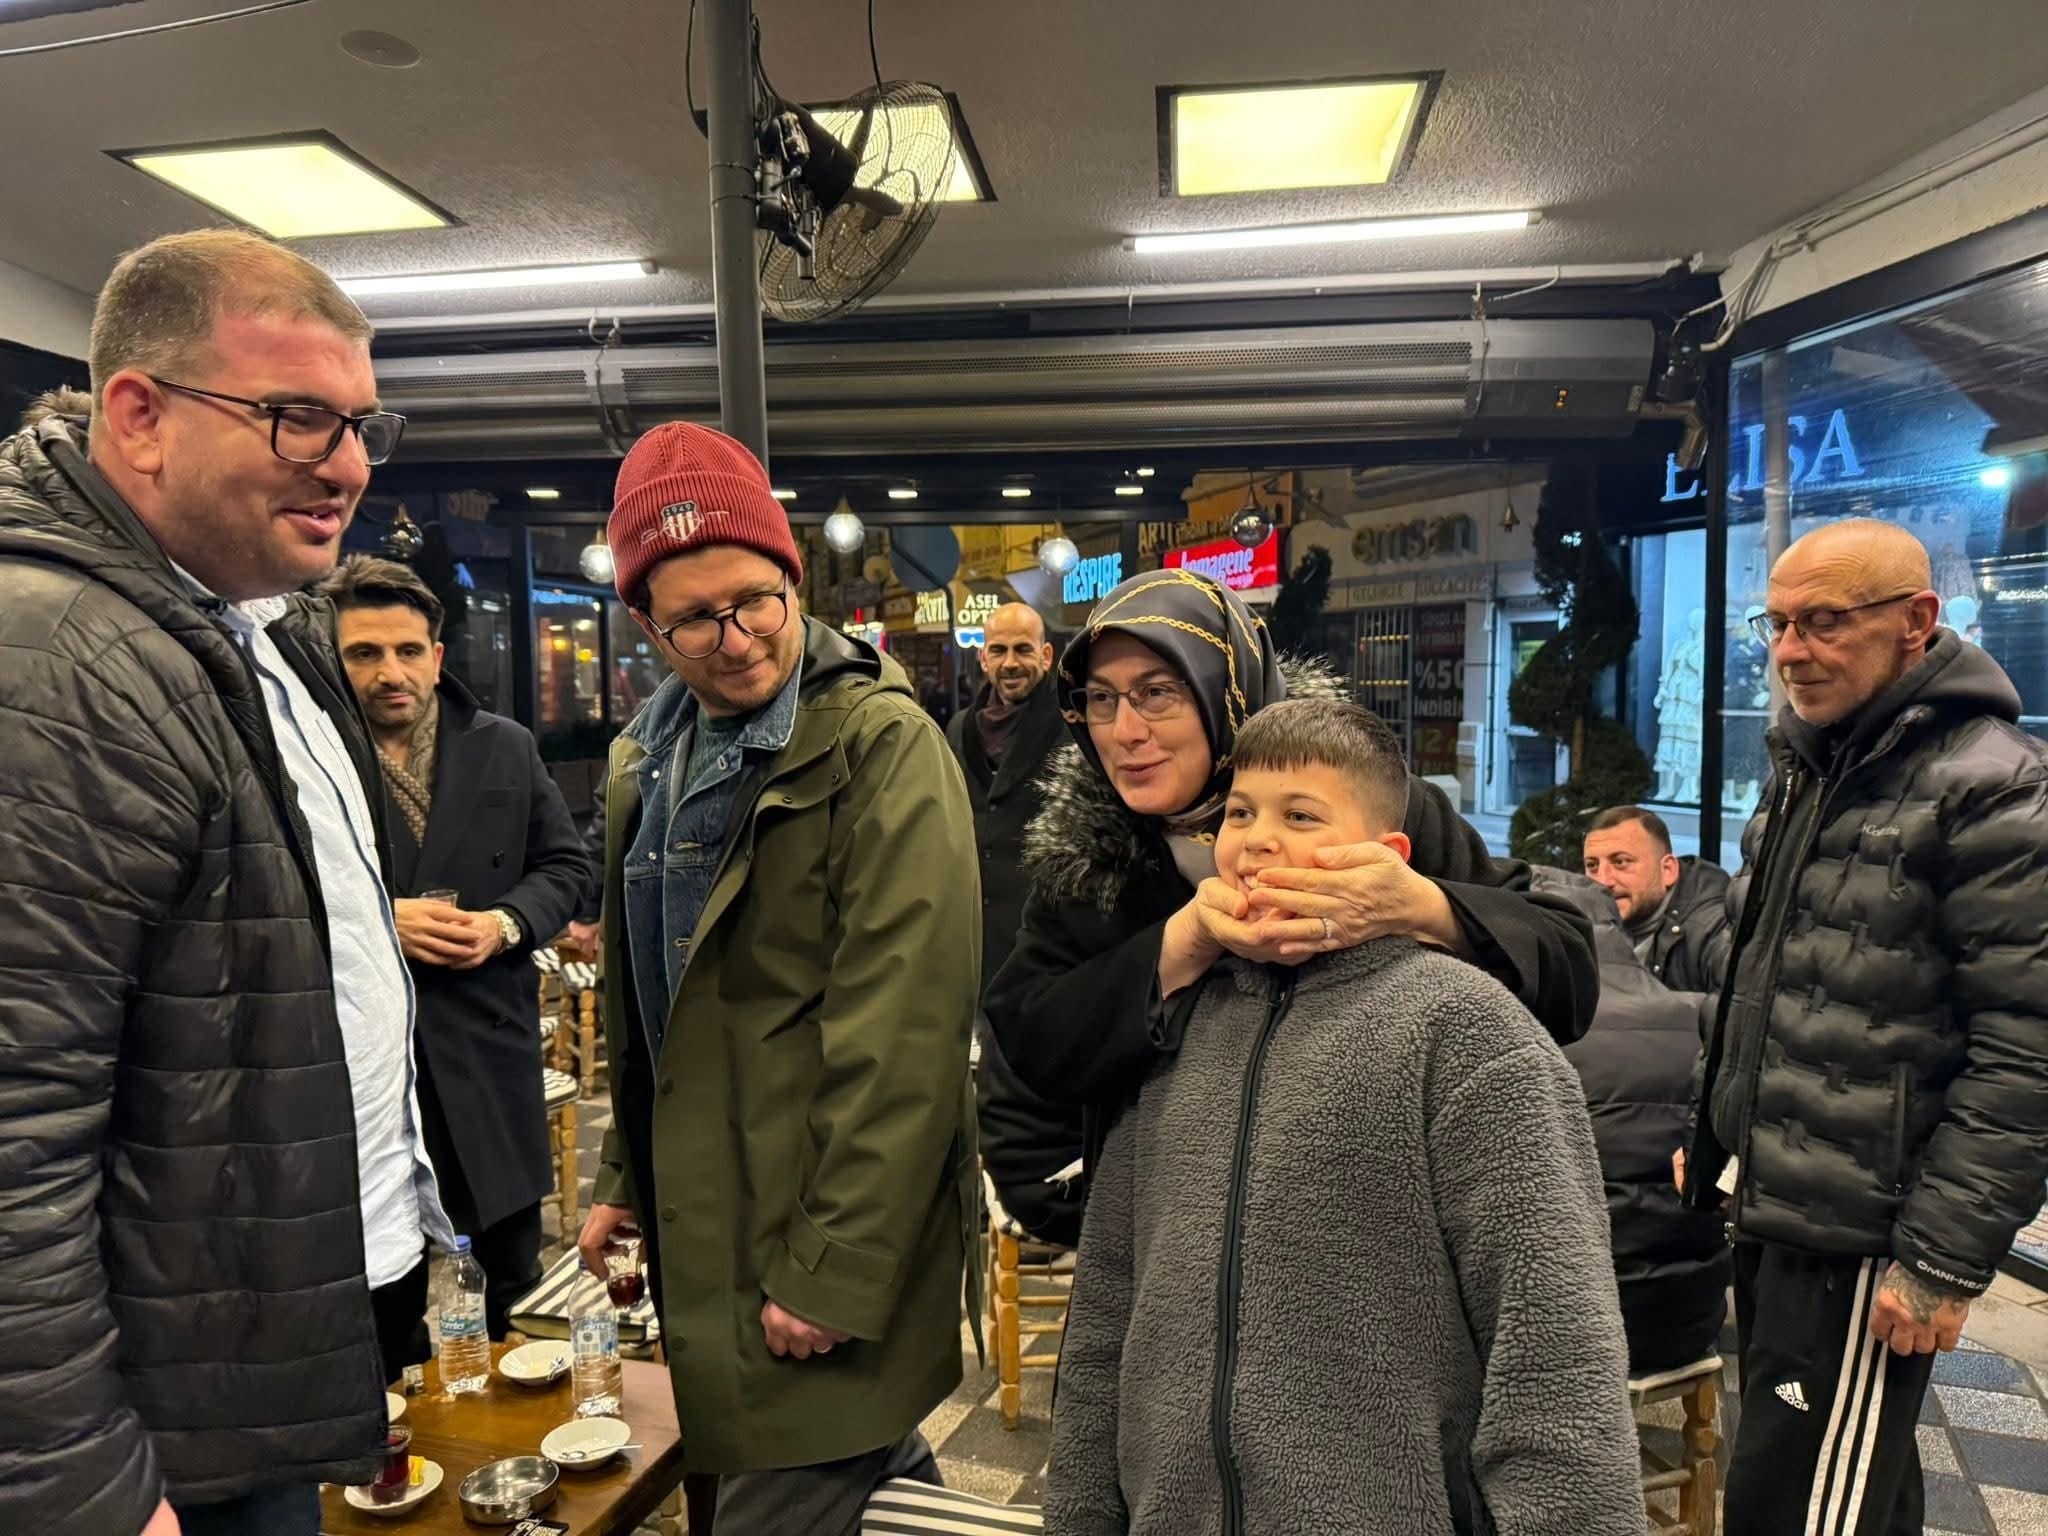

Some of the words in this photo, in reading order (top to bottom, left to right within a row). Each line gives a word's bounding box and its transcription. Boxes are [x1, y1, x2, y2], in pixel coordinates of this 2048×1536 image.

[964, 593, 1000, 609] ASEL
[957, 608, 996, 625] OPT
[1774, 1384, 1810, 1412] adidas
